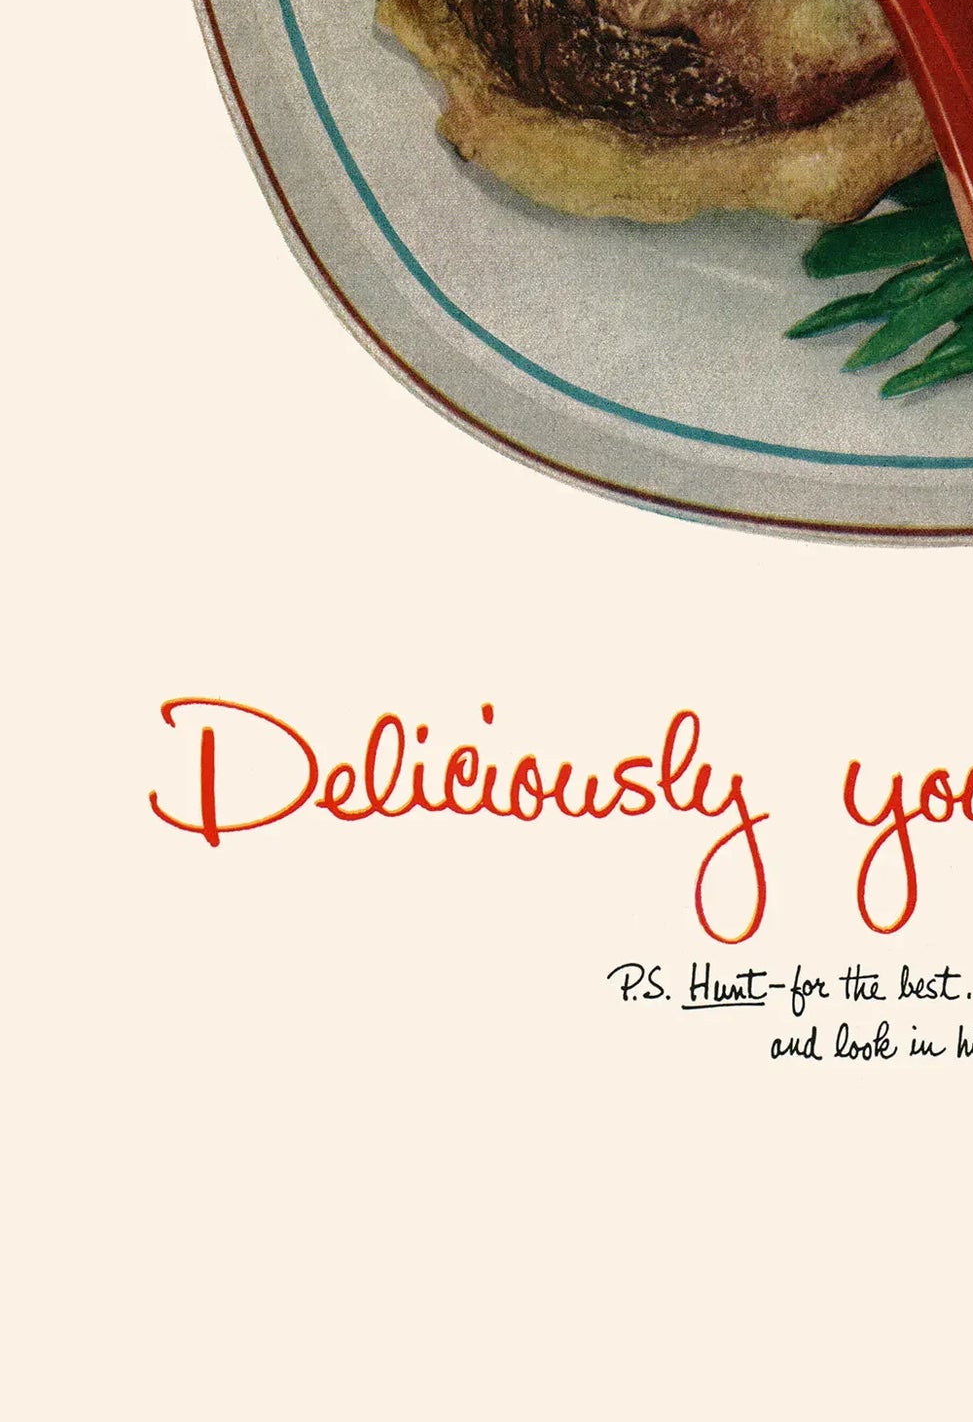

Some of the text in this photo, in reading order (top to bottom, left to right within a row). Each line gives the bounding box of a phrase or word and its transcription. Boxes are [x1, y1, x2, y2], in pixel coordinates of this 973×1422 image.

[148, 696, 770, 945] Deliciously
[607, 962, 671, 1001] P.S.
[839, 963, 887, 1002] the
[898, 964, 972, 1001] best.
[771, 1025, 823, 1061] and
[834, 1020, 898, 1061] look
[909, 1024, 947, 1058] in
